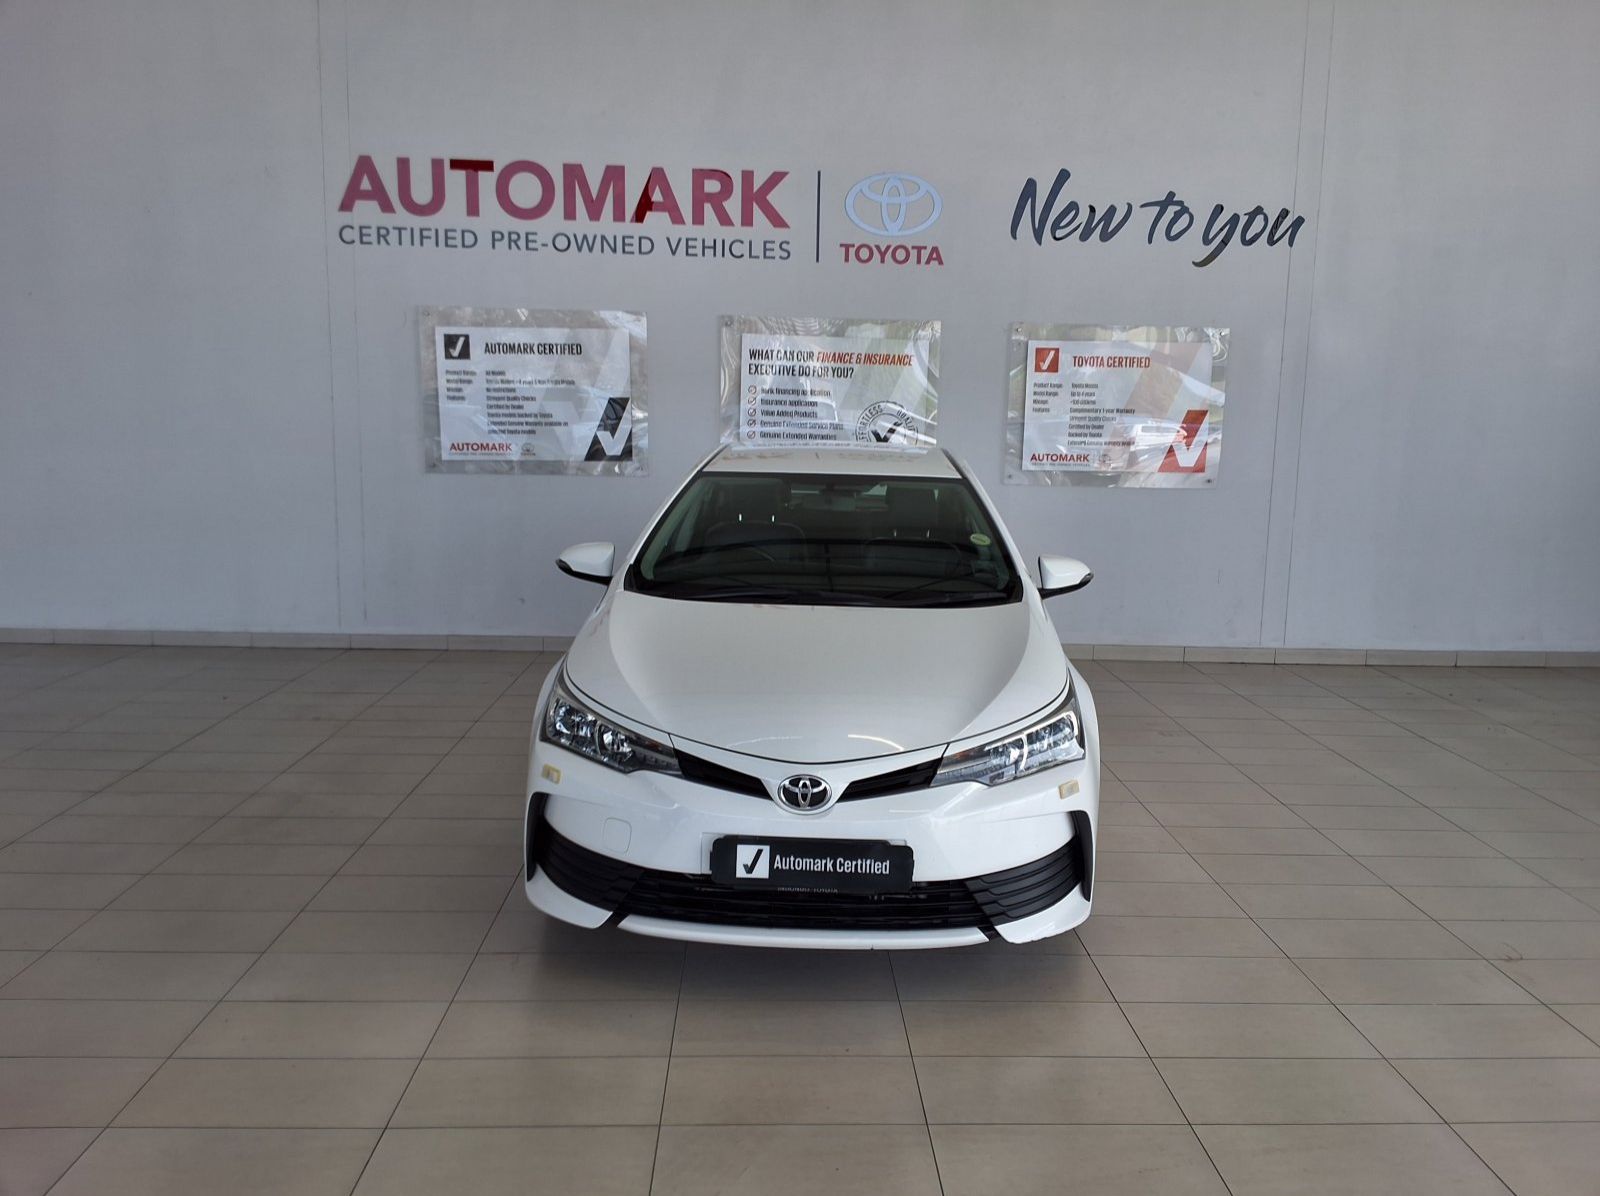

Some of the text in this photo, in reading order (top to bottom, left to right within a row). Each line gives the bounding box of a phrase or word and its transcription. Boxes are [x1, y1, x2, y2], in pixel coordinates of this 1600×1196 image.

[338, 154, 790, 229] AUTOMARK
[1010, 168, 1305, 268] New to you
[338, 225, 791, 260] CERTIFIED PRE-OWNED VEHICLES
[839, 243, 944, 265] TOYOTA
[484, 342, 582, 355] AUTOMARK CERTIFIED
[749, 349, 913, 367] WHAT CAN OUR FINANCE & INSURANCE
[1073, 356, 1151, 368] TOYOTA CERTIFIED
[748, 363, 854, 379] EXECUTIVE DO FOR YOU?
[449, 442, 512, 452] AUTOMARK
[1030, 453, 1089, 462] AUTOMARK
[774, 854, 890, 874] Automark Certified
